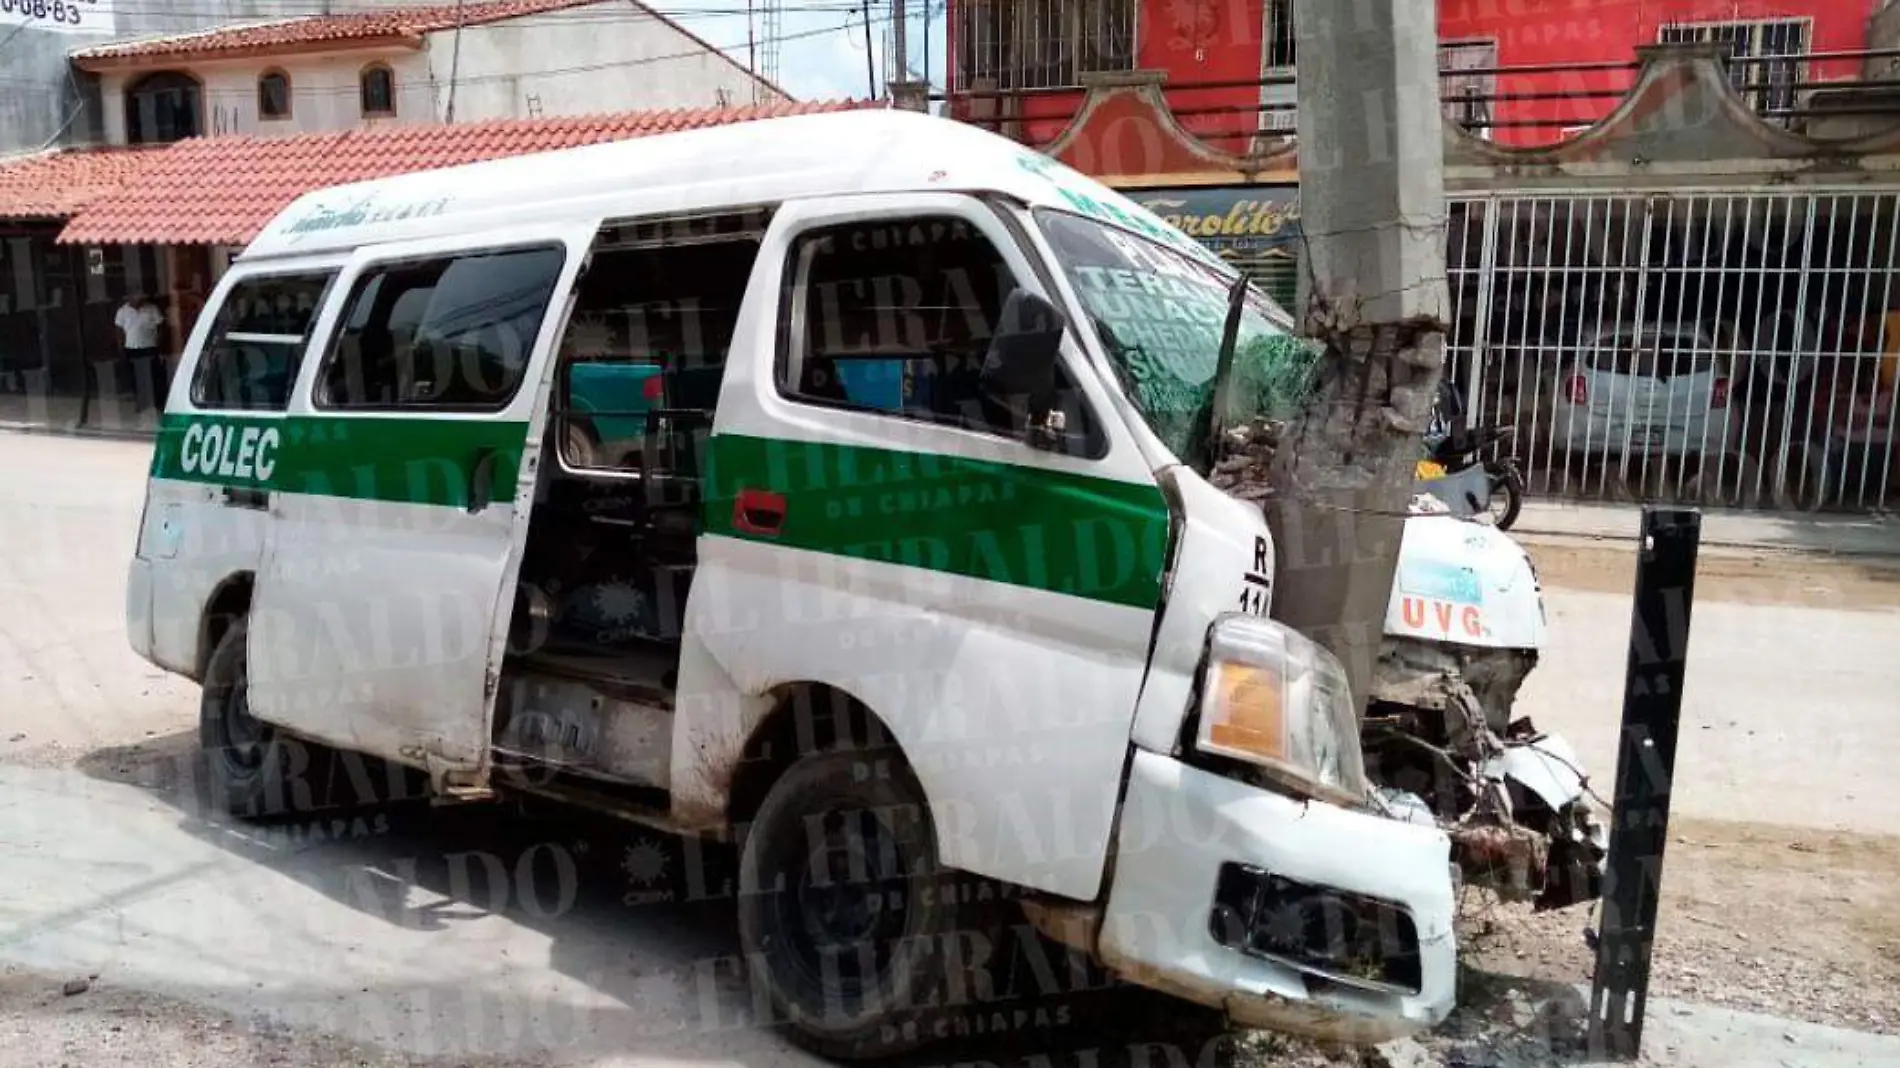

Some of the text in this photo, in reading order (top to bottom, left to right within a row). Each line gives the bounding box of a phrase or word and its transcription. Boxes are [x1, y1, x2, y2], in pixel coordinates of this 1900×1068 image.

[1141, 199, 1283, 236] arolito
[180, 422, 280, 481] COLEC
[1254, 536, 1267, 574] R
